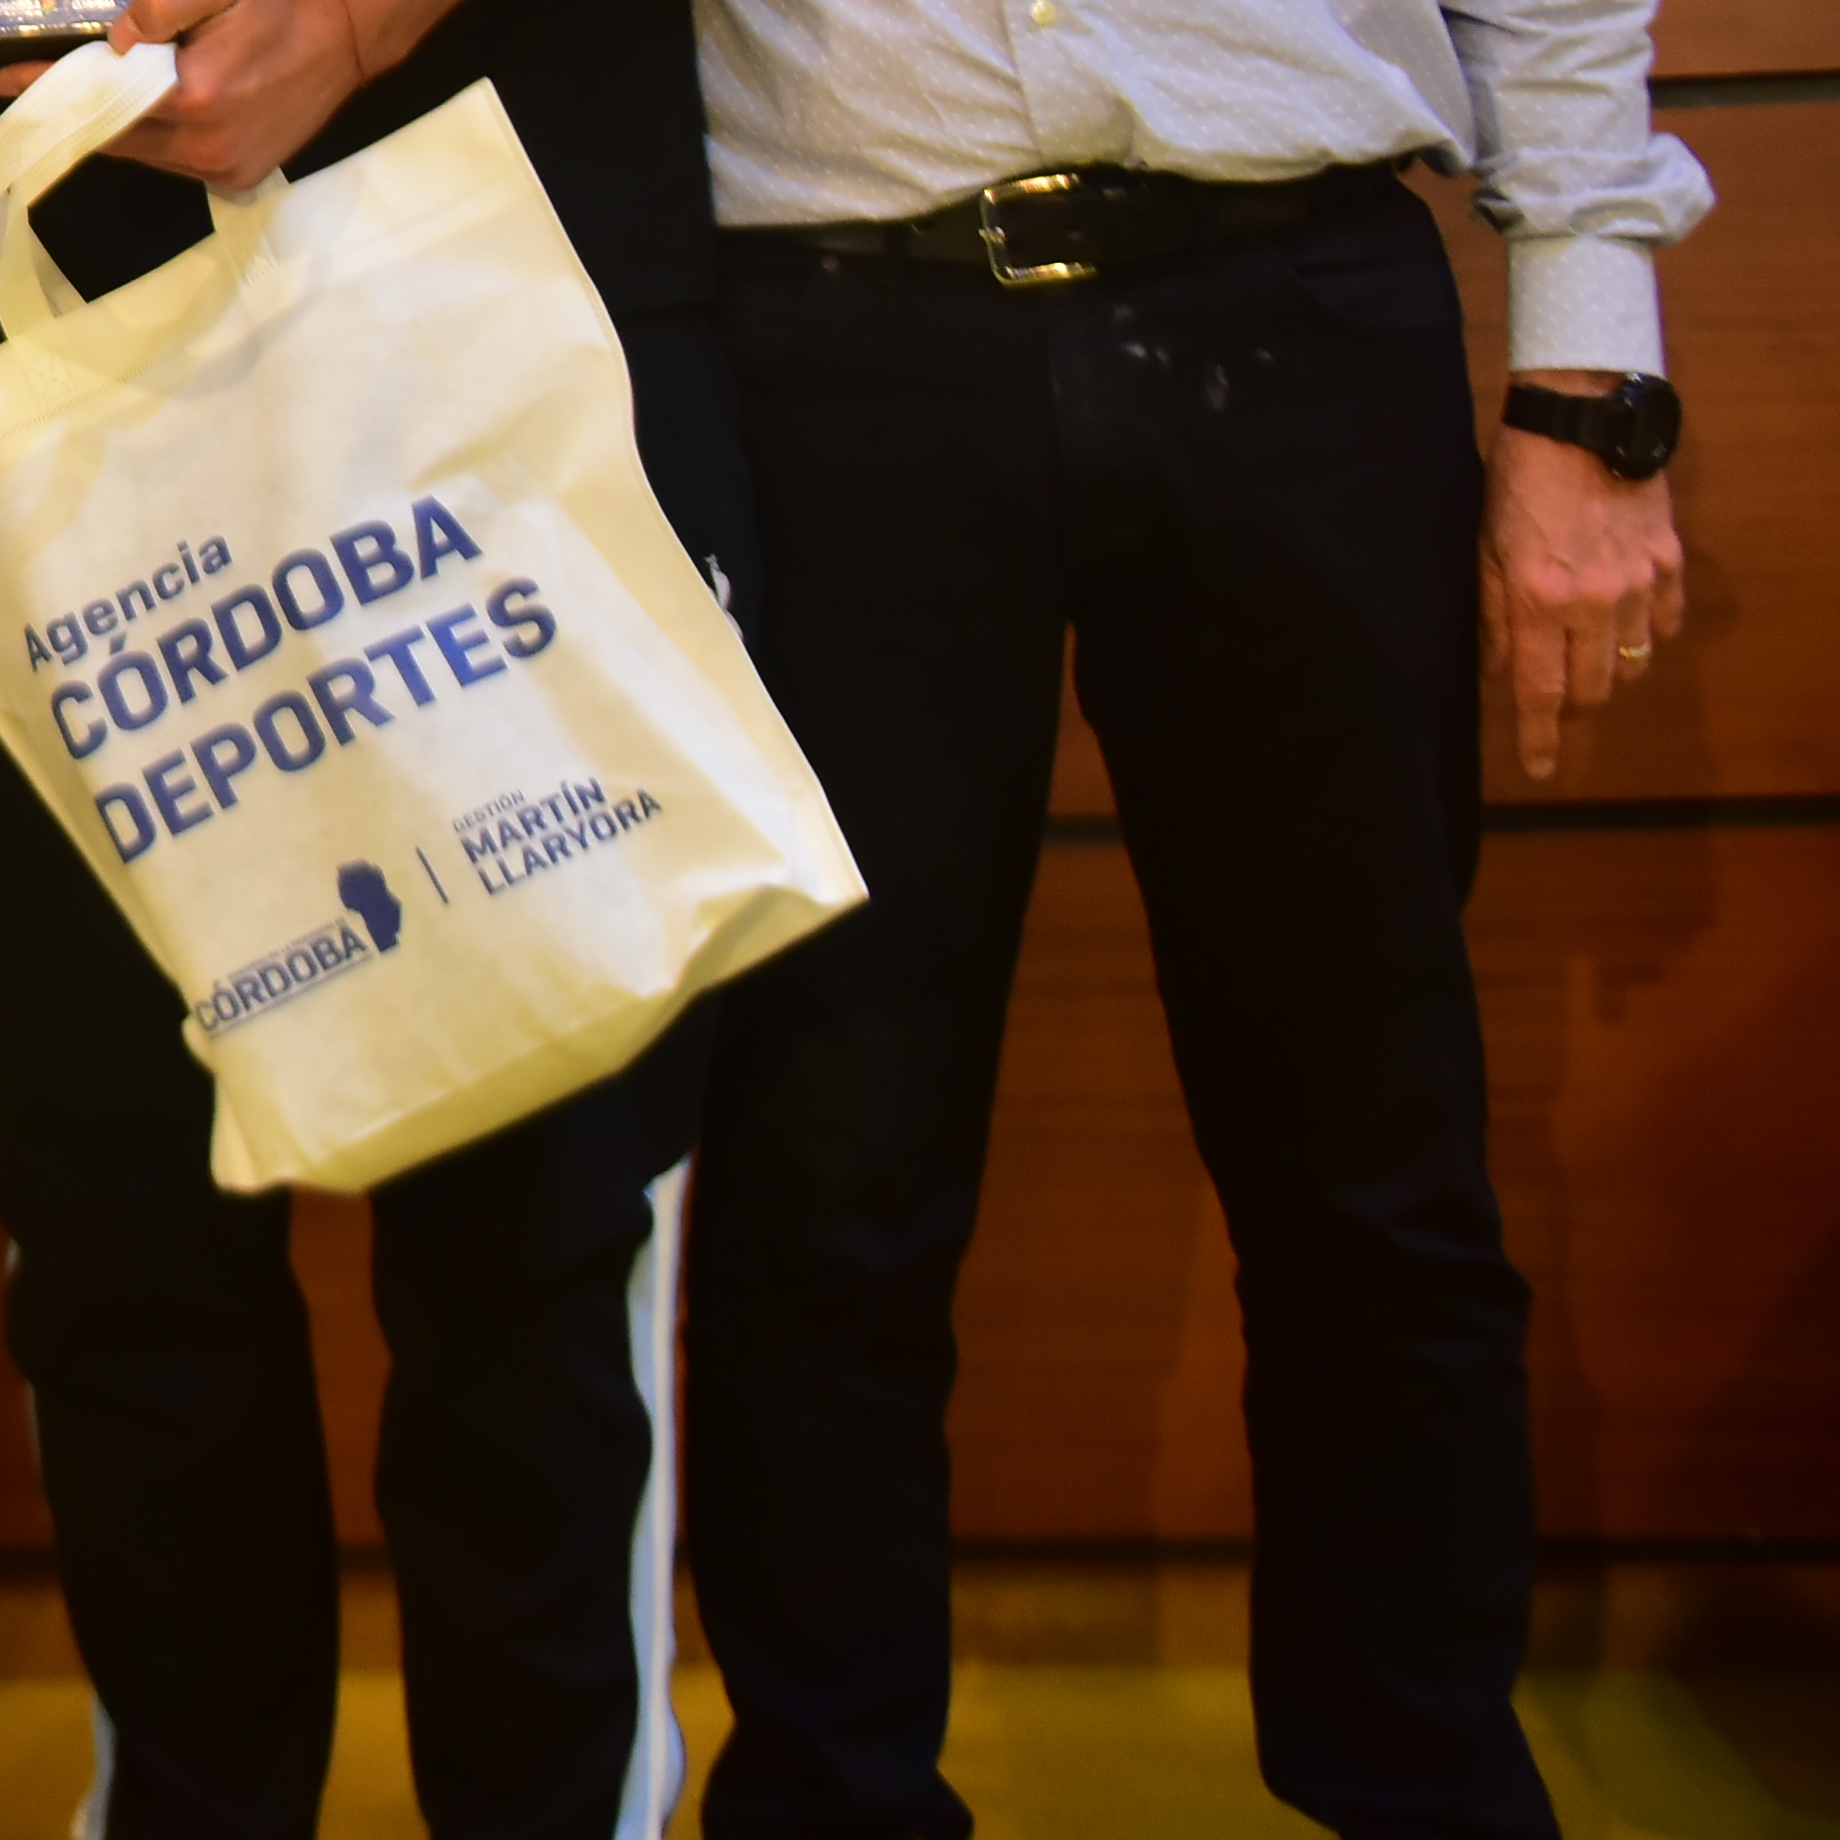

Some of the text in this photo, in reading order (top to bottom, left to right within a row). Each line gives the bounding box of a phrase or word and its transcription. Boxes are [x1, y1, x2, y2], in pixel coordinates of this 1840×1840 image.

[23, 533, 233, 672] Agencia
[50, 494, 484, 761] CÓRDOBA
[94, 576, 558, 865] DEPORTES
[460, 777, 608, 864] MARTÍN
[477, 789, 662, 896] LLARYORA
[192, 924, 368, 1033] CÓRDOBA
